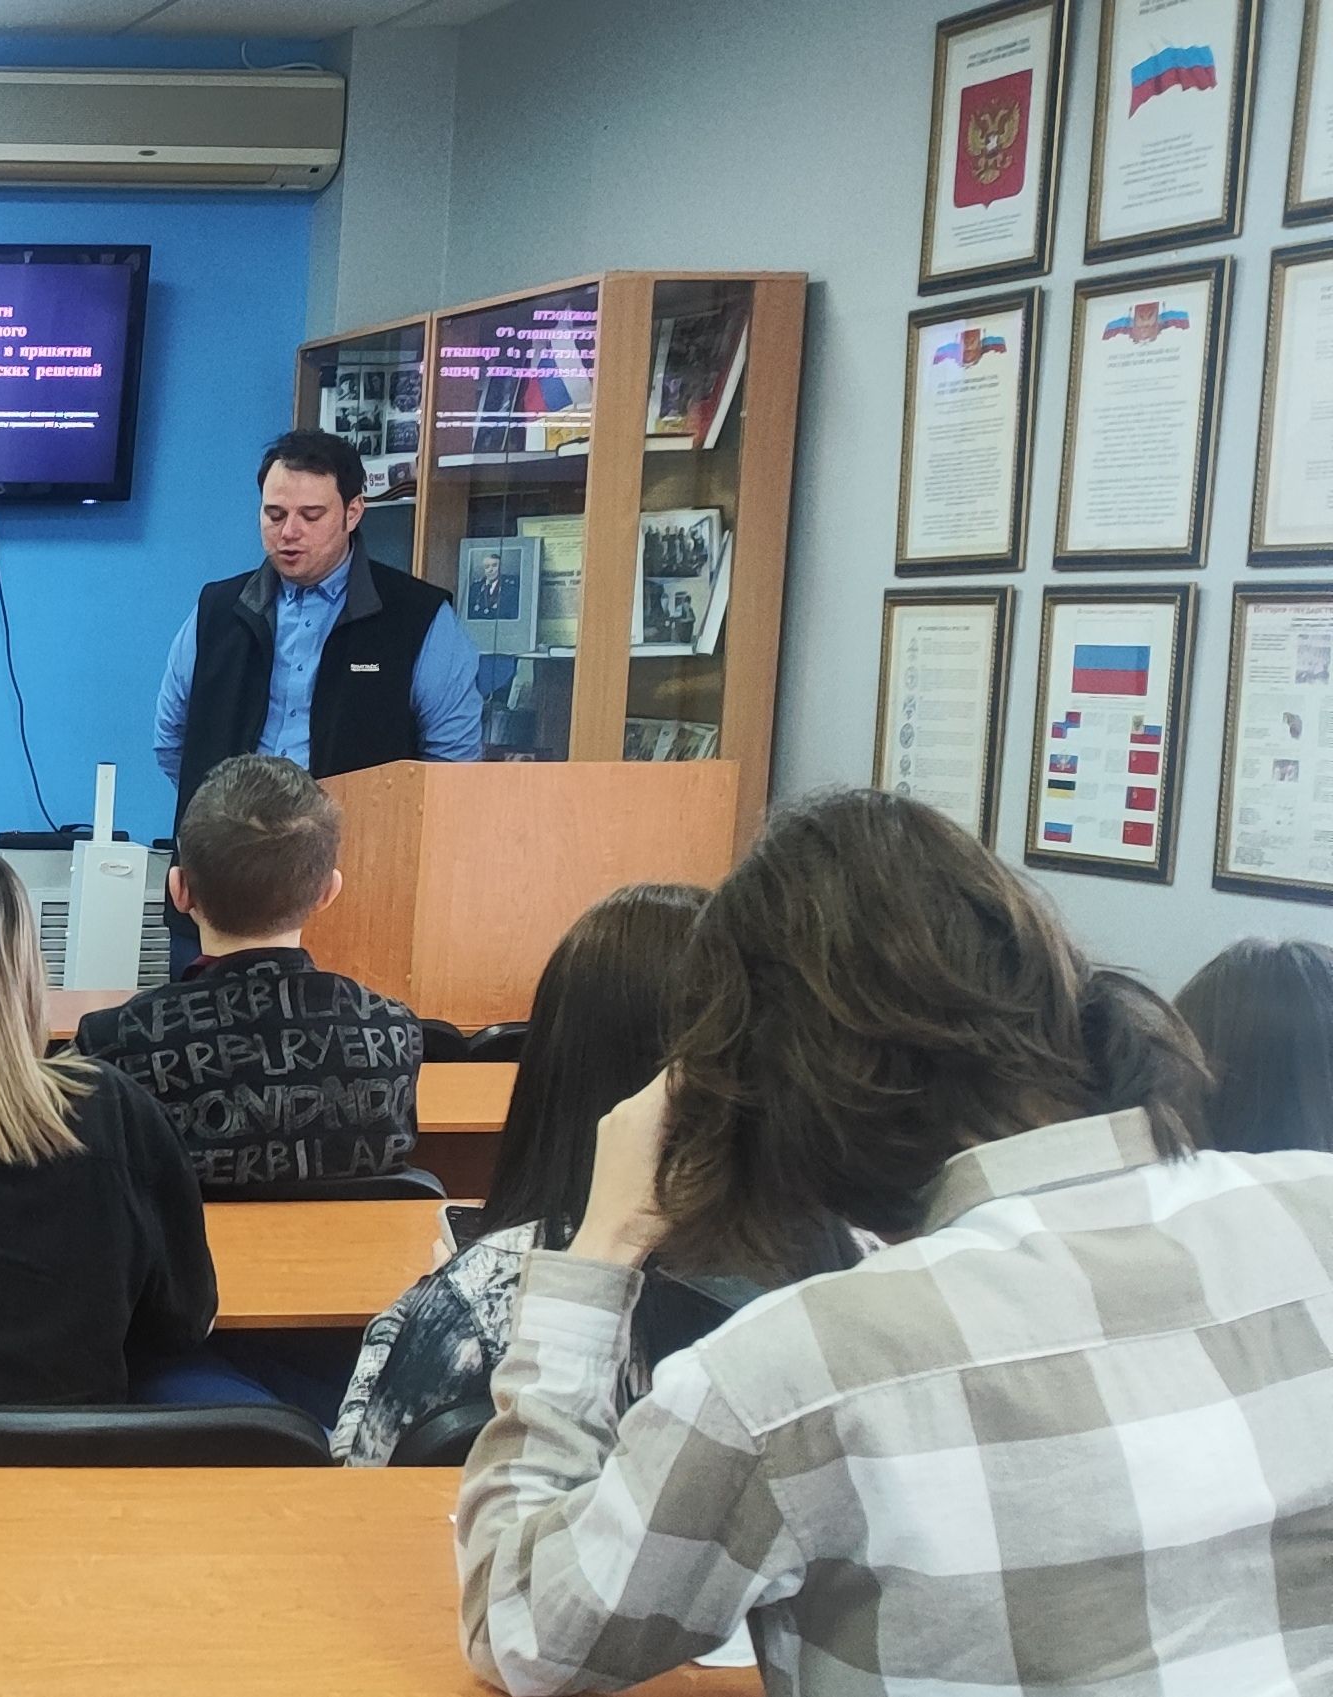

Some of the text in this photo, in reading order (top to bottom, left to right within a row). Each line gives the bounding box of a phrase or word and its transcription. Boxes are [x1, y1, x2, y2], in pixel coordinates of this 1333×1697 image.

[3, 346, 14, 358] в
[19, 345, 93, 361] принятии
[35, 363, 103, 380] решений
